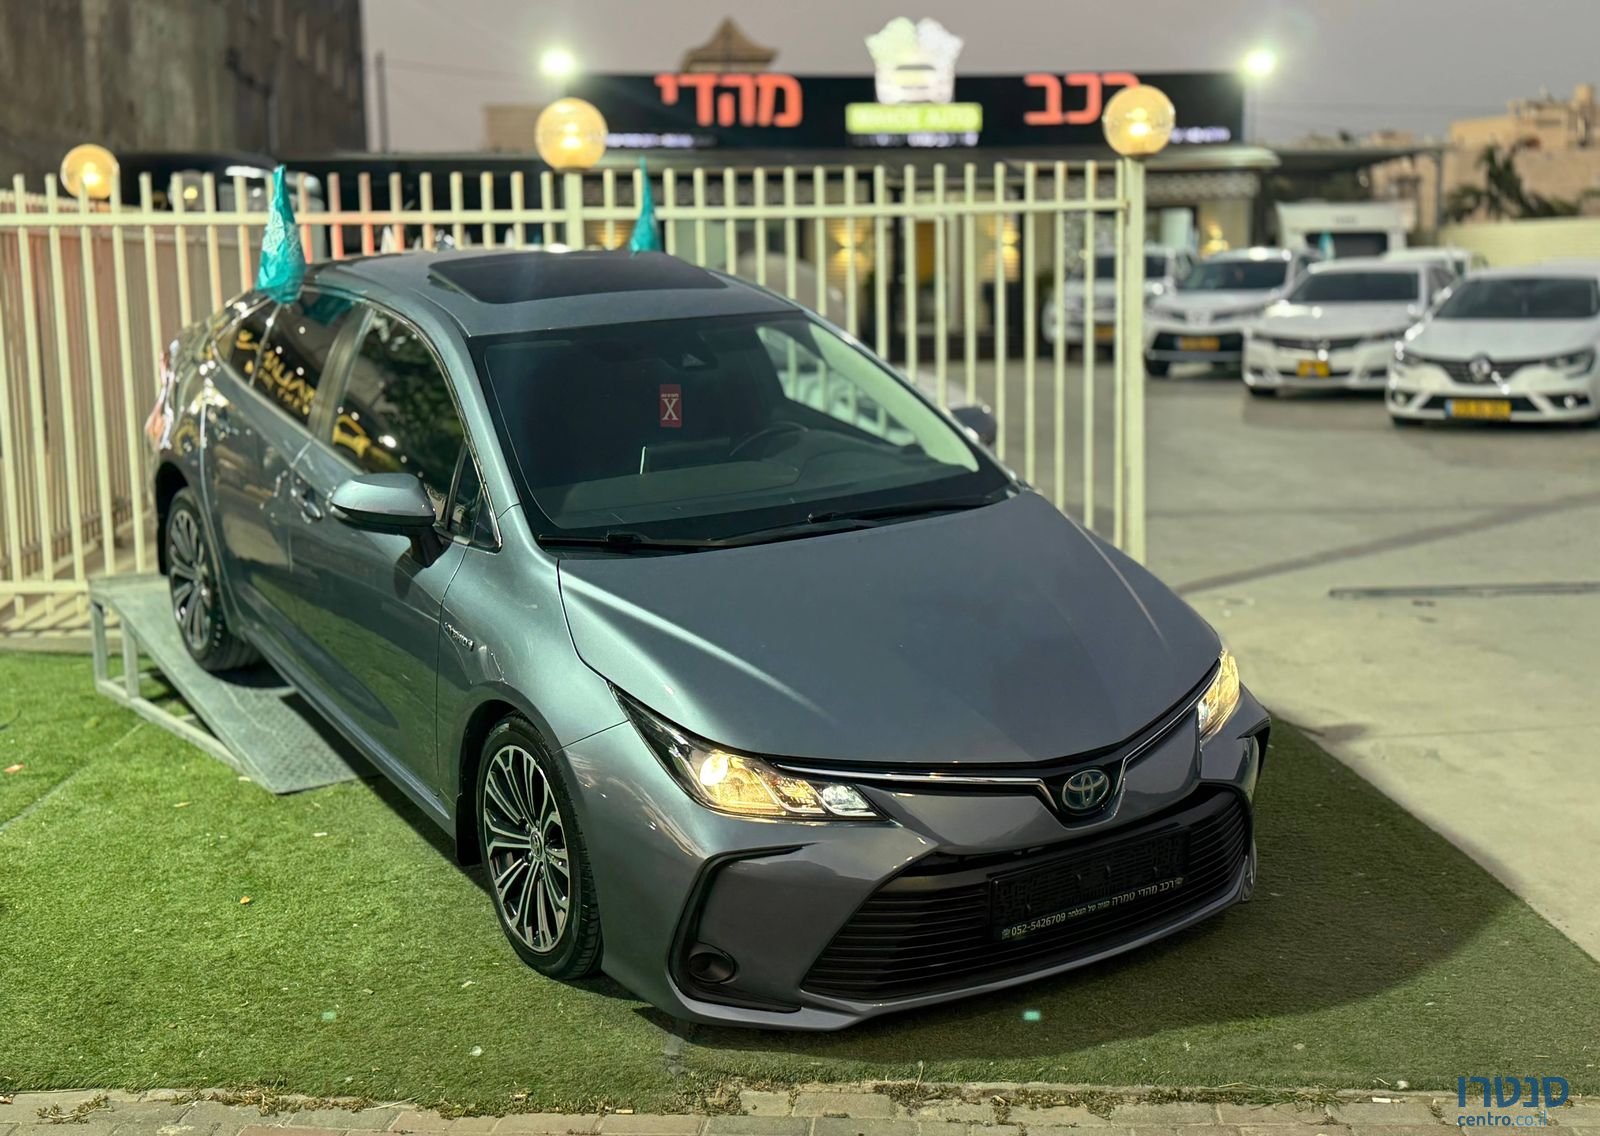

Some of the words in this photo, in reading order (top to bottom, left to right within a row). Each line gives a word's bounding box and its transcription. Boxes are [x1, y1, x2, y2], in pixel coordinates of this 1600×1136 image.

[654, 73, 803, 127] מהדי
[661, 398, 680, 421] X
[1137, 884, 1158, 897] מהדי
[1159, 880, 1174, 893] רכב
[1111, 891, 1136, 906] טמרה
[1011, 912, 1066, 937] 052-5426709
